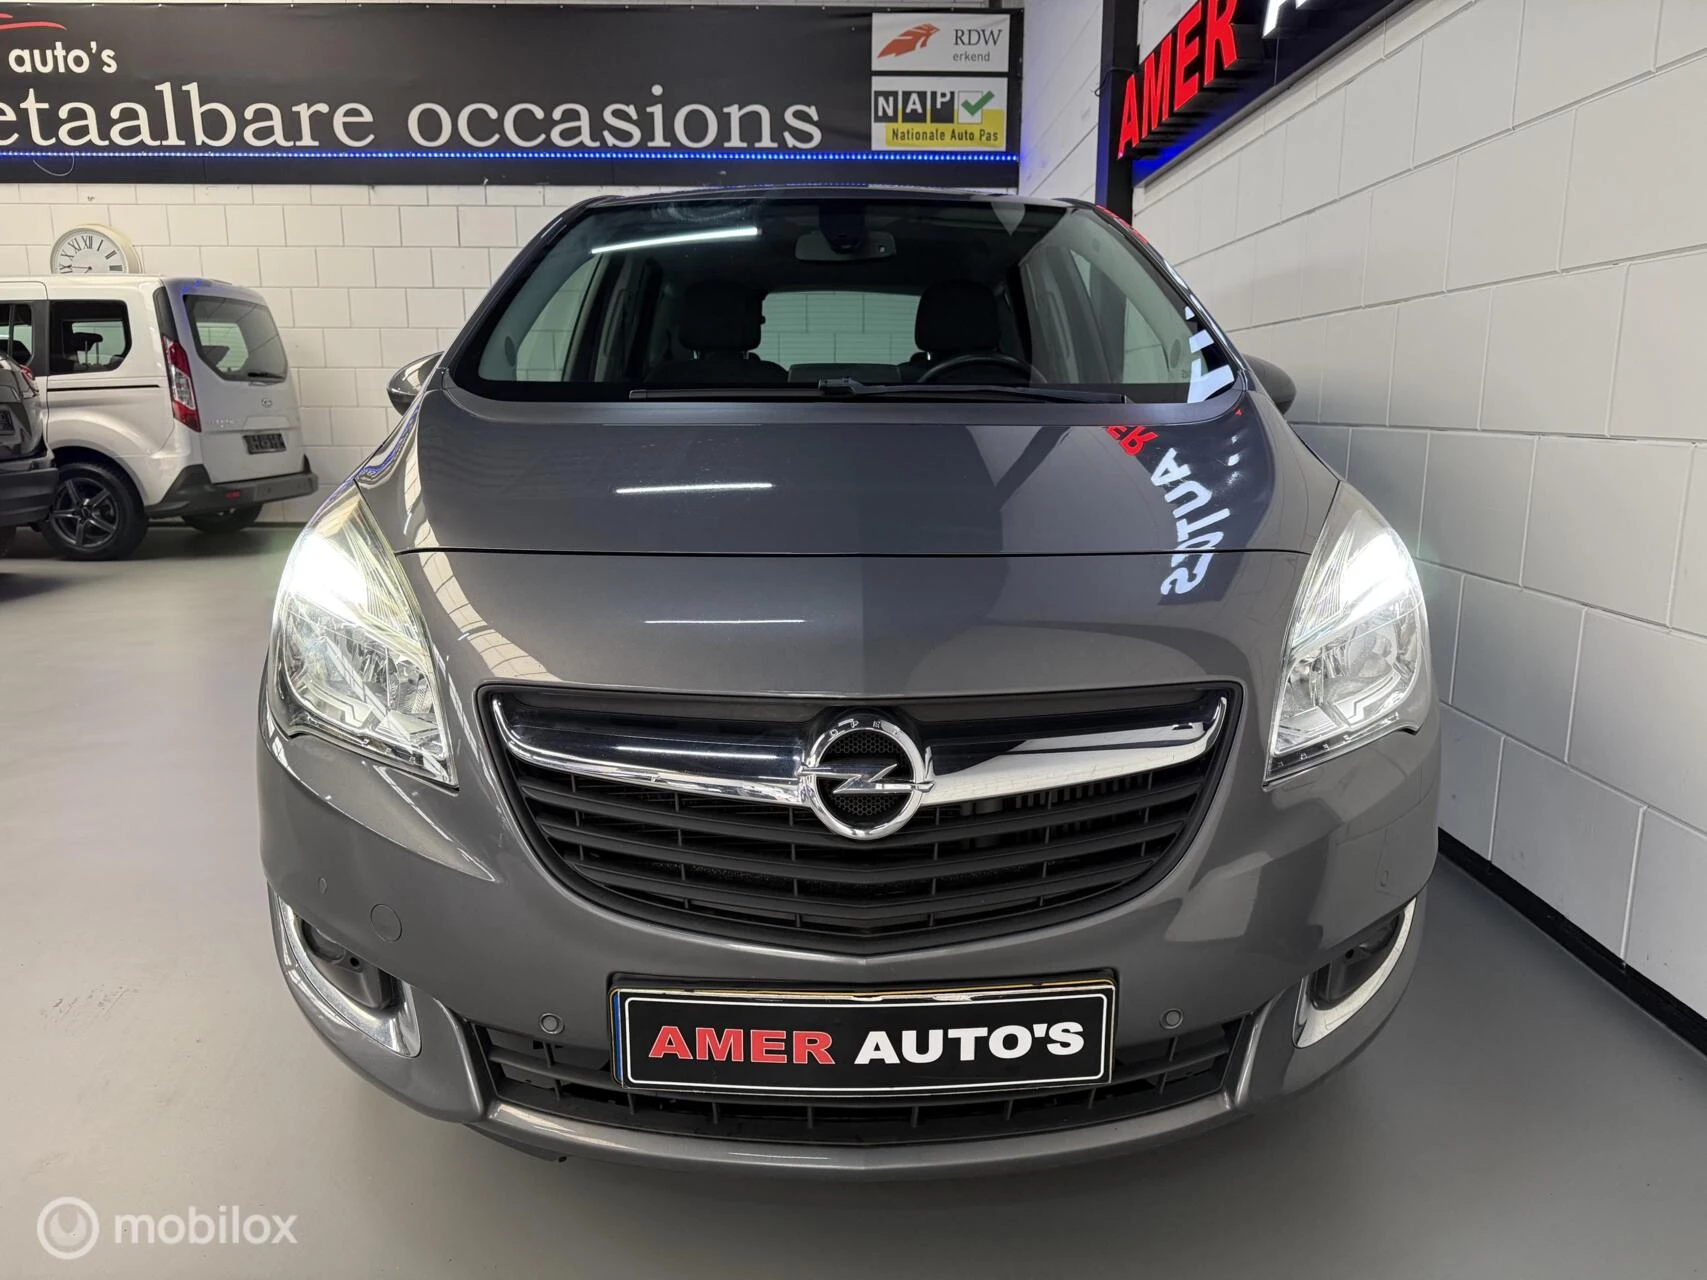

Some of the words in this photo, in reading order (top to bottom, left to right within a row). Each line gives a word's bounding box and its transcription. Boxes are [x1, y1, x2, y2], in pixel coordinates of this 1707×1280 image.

[953, 29, 1003, 47] RDW
[8, 41, 118, 74] auto's
[952, 51, 991, 62] erkend
[1118, 0, 1237, 160] AMER
[407, 84, 823, 149] occasions
[877, 91, 951, 117] NAP
[891, 128, 946, 142] Nationale
[950, 129, 975, 142] Auto
[979, 129, 999, 142] Pas
[648, 1025, 836, 1065] AMER
[854, 1021, 1085, 1065] AUTO'S
